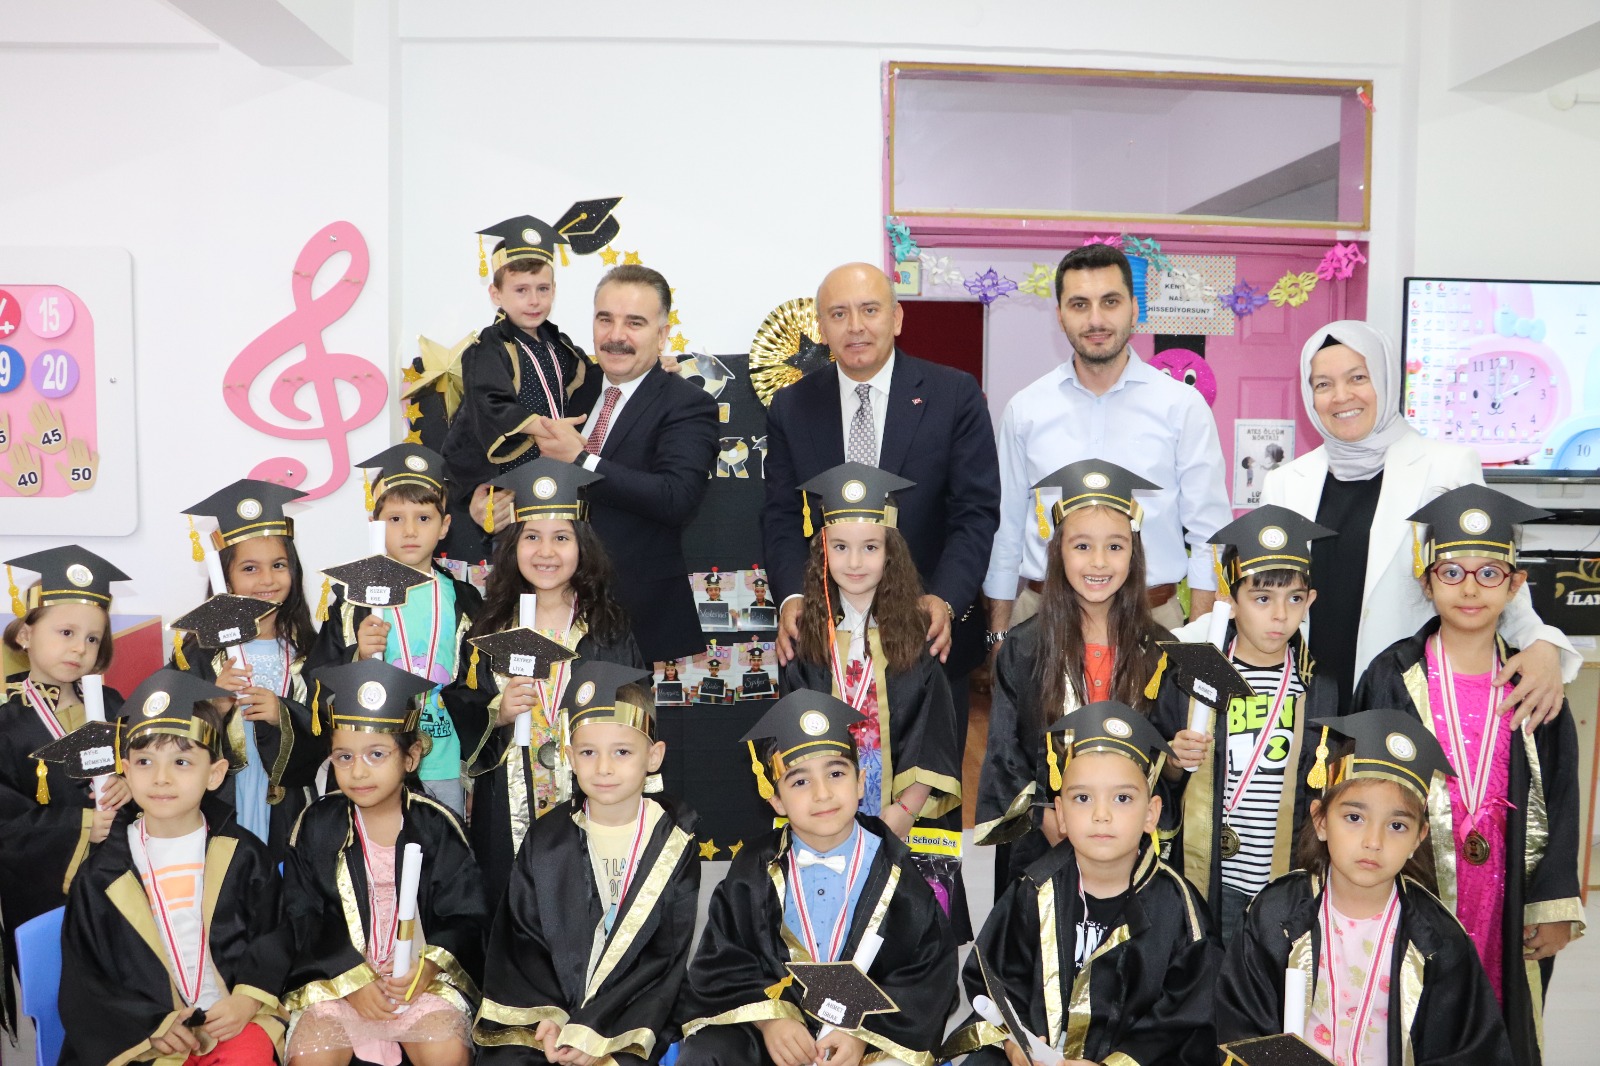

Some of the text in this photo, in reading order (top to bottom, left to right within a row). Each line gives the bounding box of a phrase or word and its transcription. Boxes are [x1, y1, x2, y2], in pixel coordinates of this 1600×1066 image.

[39, 297, 60, 332] 15
[42, 354, 68, 391] 20
[41, 428, 62, 445] 45
[1577, 444, 1591, 457] 10
[17, 468, 92, 486] 40 50
[1229, 694, 1294, 733] BEN
[912, 836, 940, 845] School
[942, 838, 957, 847] Set
